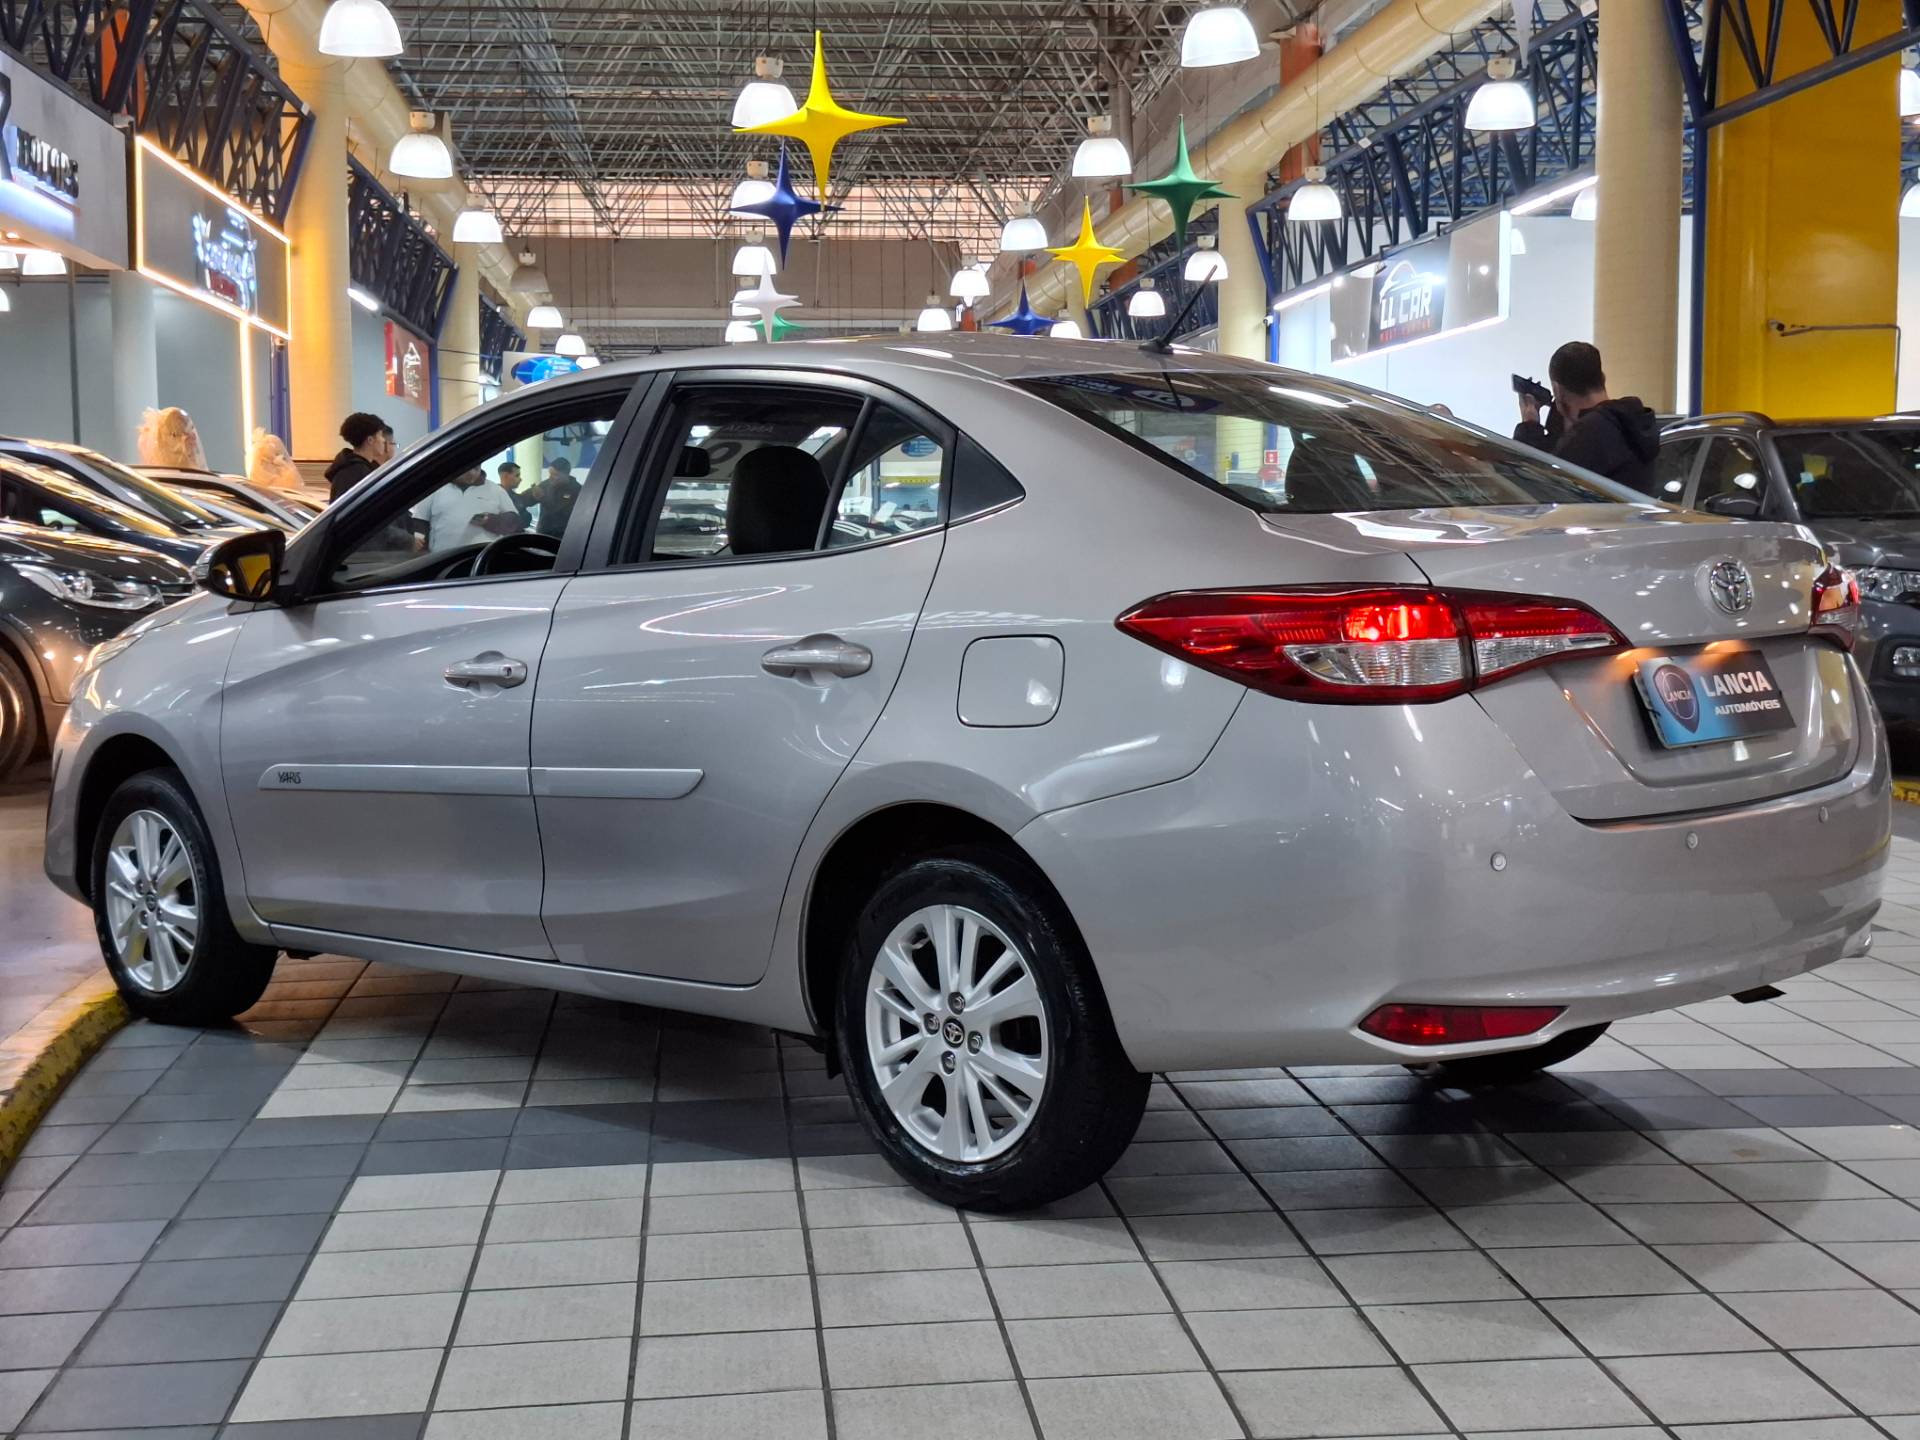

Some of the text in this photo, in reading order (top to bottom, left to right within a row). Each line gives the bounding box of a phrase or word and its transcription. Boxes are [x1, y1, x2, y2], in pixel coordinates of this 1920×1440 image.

[1380, 296, 1396, 331] LL
[1399, 285, 1432, 324] CAR
[1700, 671, 1773, 697] LANCIA
[1715, 699, 1781, 715] AUTOMÓVEIS
